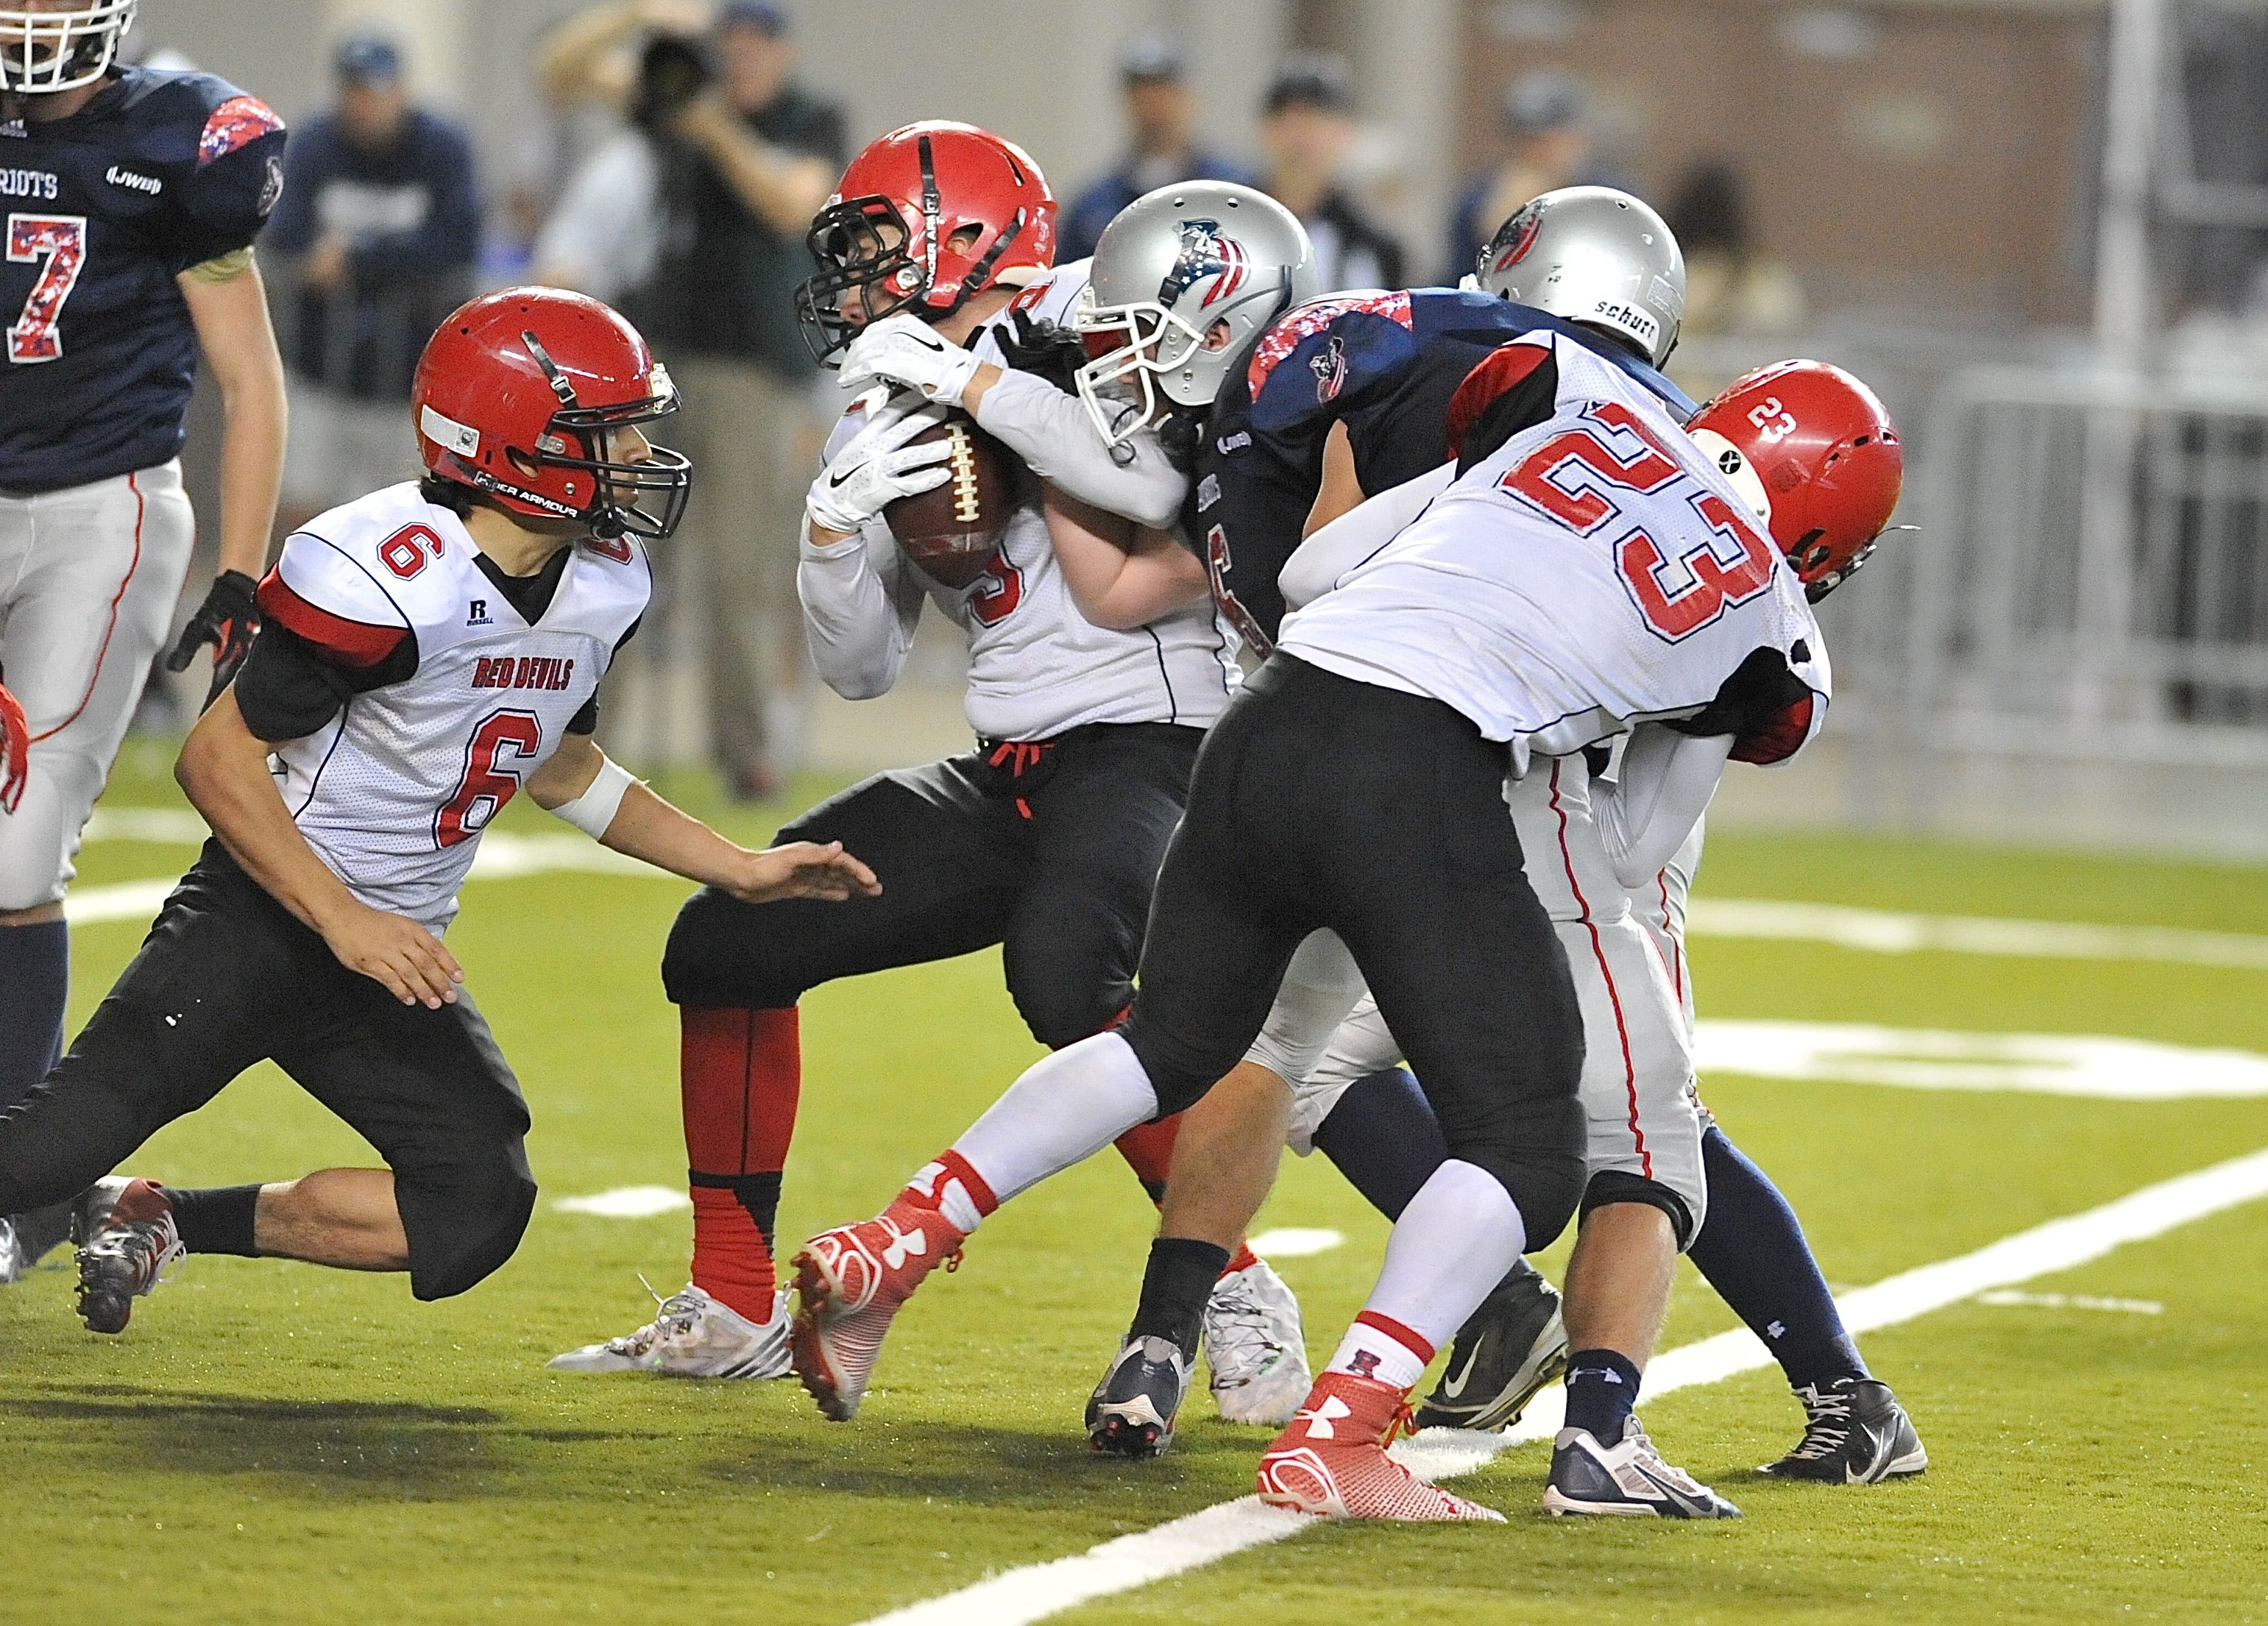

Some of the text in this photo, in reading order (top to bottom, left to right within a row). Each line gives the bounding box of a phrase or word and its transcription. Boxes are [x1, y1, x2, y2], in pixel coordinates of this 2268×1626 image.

[6, 213, 87, 363] 7
[1595, 301, 1655, 338] schutt
[1746, 397, 1796, 444] 23
[519, 491, 578, 518] ARMOUR
[1492, 400, 1779, 646] 23
[377, 521, 444, 582] 6
[467, 617, 494, 627] RUSSELL
[469, 600, 486, 619] R
[471, 657, 574, 691] RED DEVILS
[431, 707, 543, 851] 6
